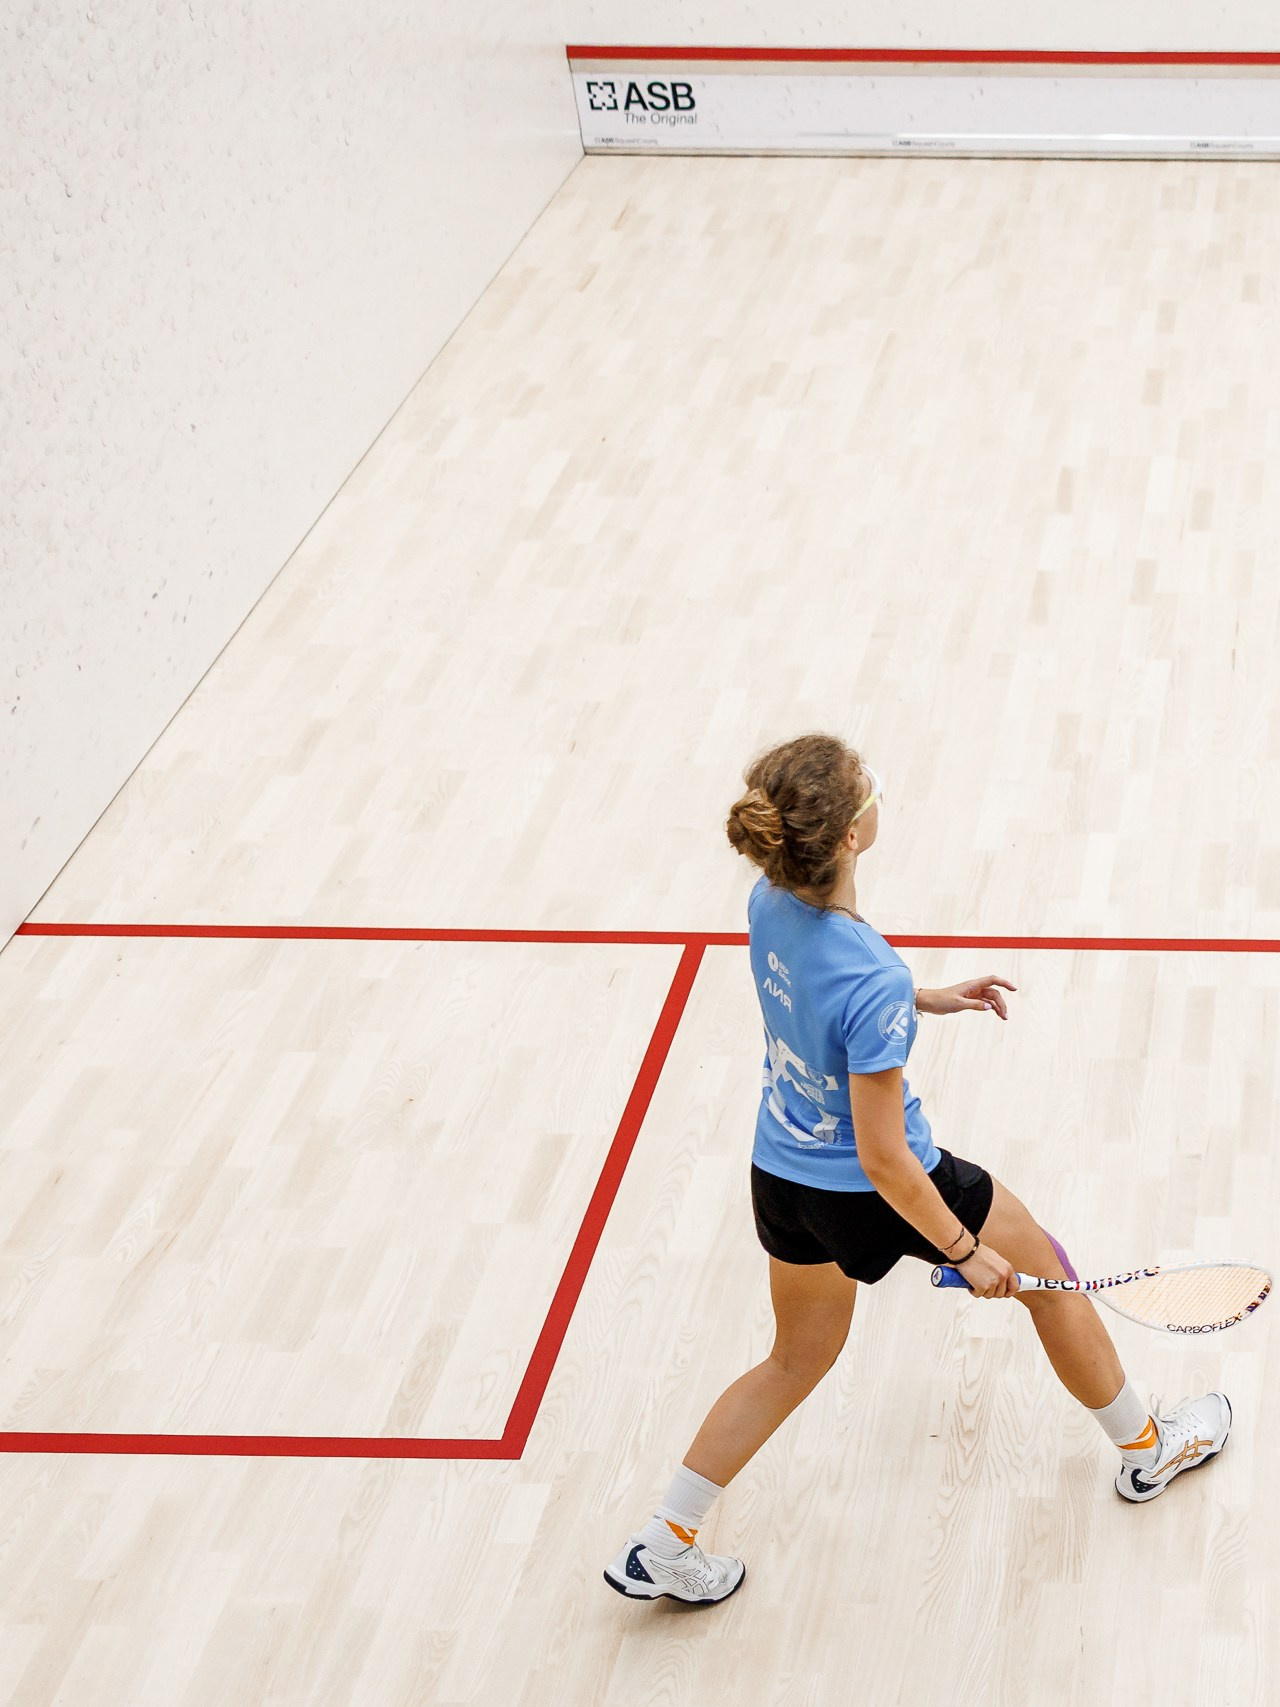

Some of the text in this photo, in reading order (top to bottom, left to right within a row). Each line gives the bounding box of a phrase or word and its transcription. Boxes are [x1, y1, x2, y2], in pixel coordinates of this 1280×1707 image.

[624, 81, 696, 111] ASB
[624, 113, 697, 126] The Original
